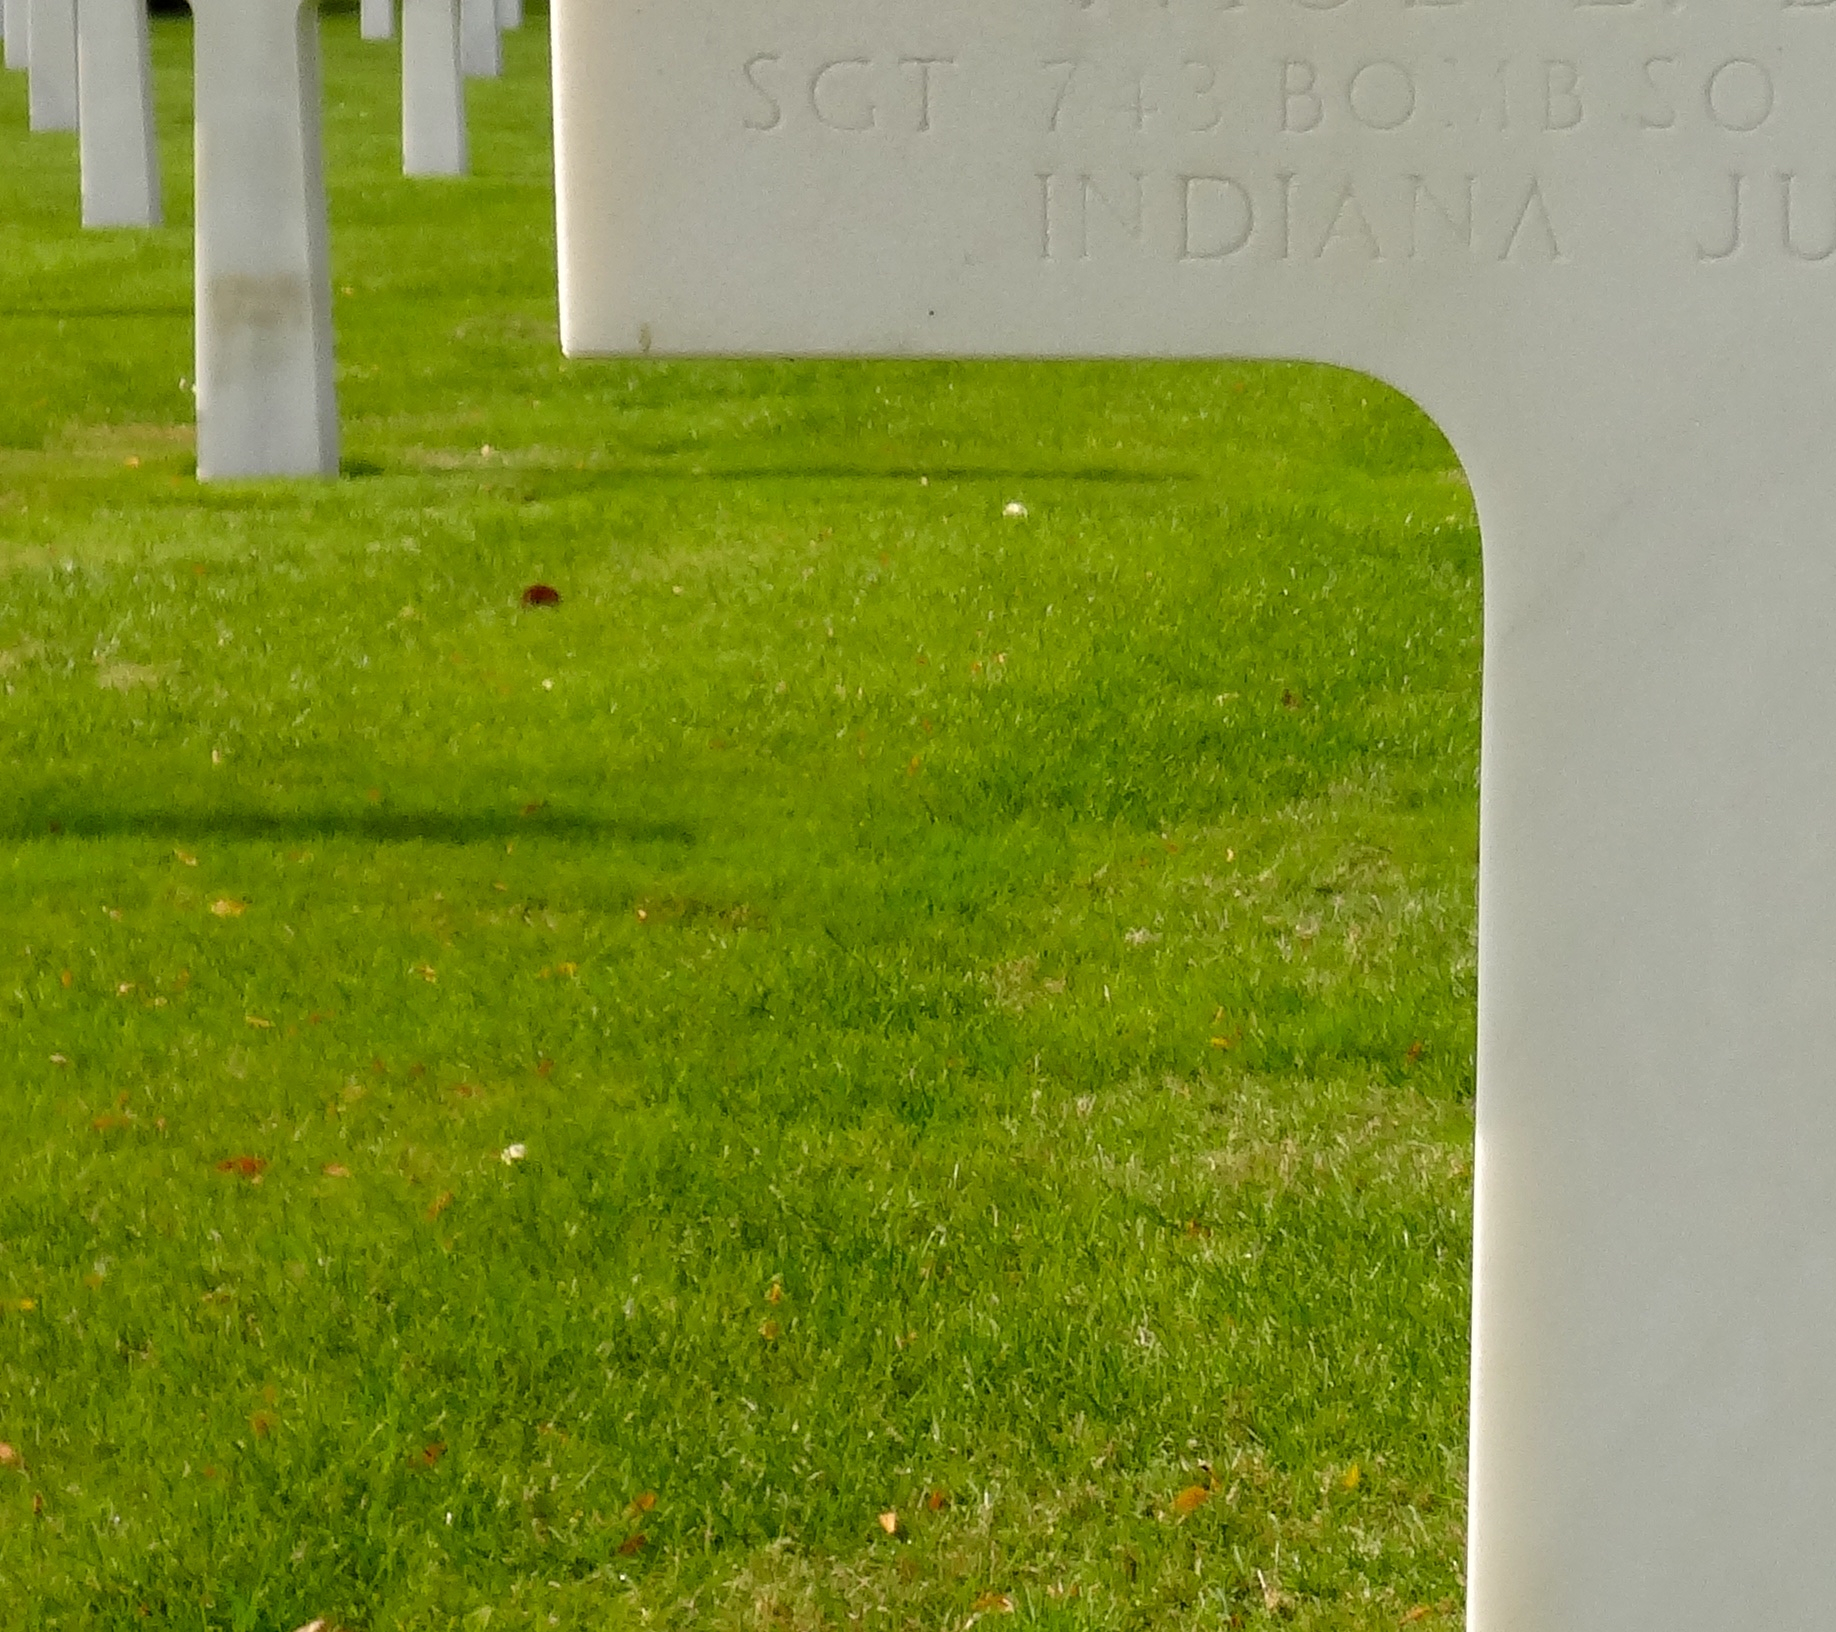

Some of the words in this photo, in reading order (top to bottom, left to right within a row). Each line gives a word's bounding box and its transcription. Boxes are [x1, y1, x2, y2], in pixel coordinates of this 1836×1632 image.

[742, 51, 956, 133] SGT
[1040, 59, 1222, 134] 743
[1034, 171, 1568, 263] INDIANA
